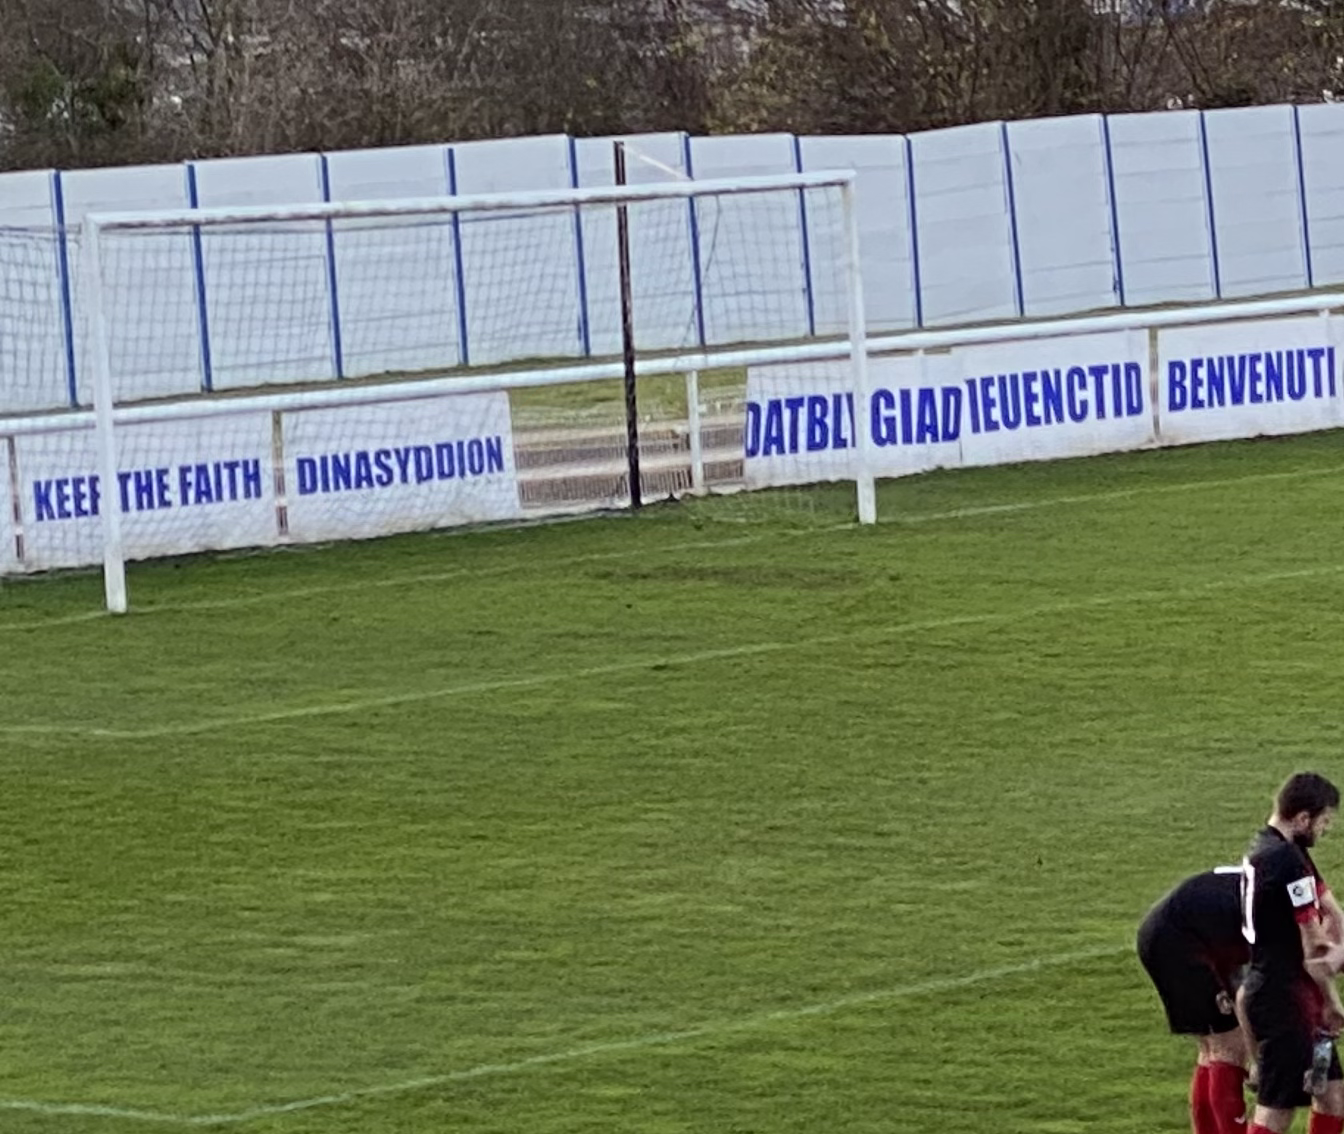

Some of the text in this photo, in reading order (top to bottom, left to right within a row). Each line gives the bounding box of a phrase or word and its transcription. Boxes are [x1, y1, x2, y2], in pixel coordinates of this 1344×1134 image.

[1167, 345, 1337, 413] BENVENUTI
[116, 467, 172, 513] THE
[178, 458, 263, 507] FAITH
[295, 435, 505, 496] DINASYDDION
